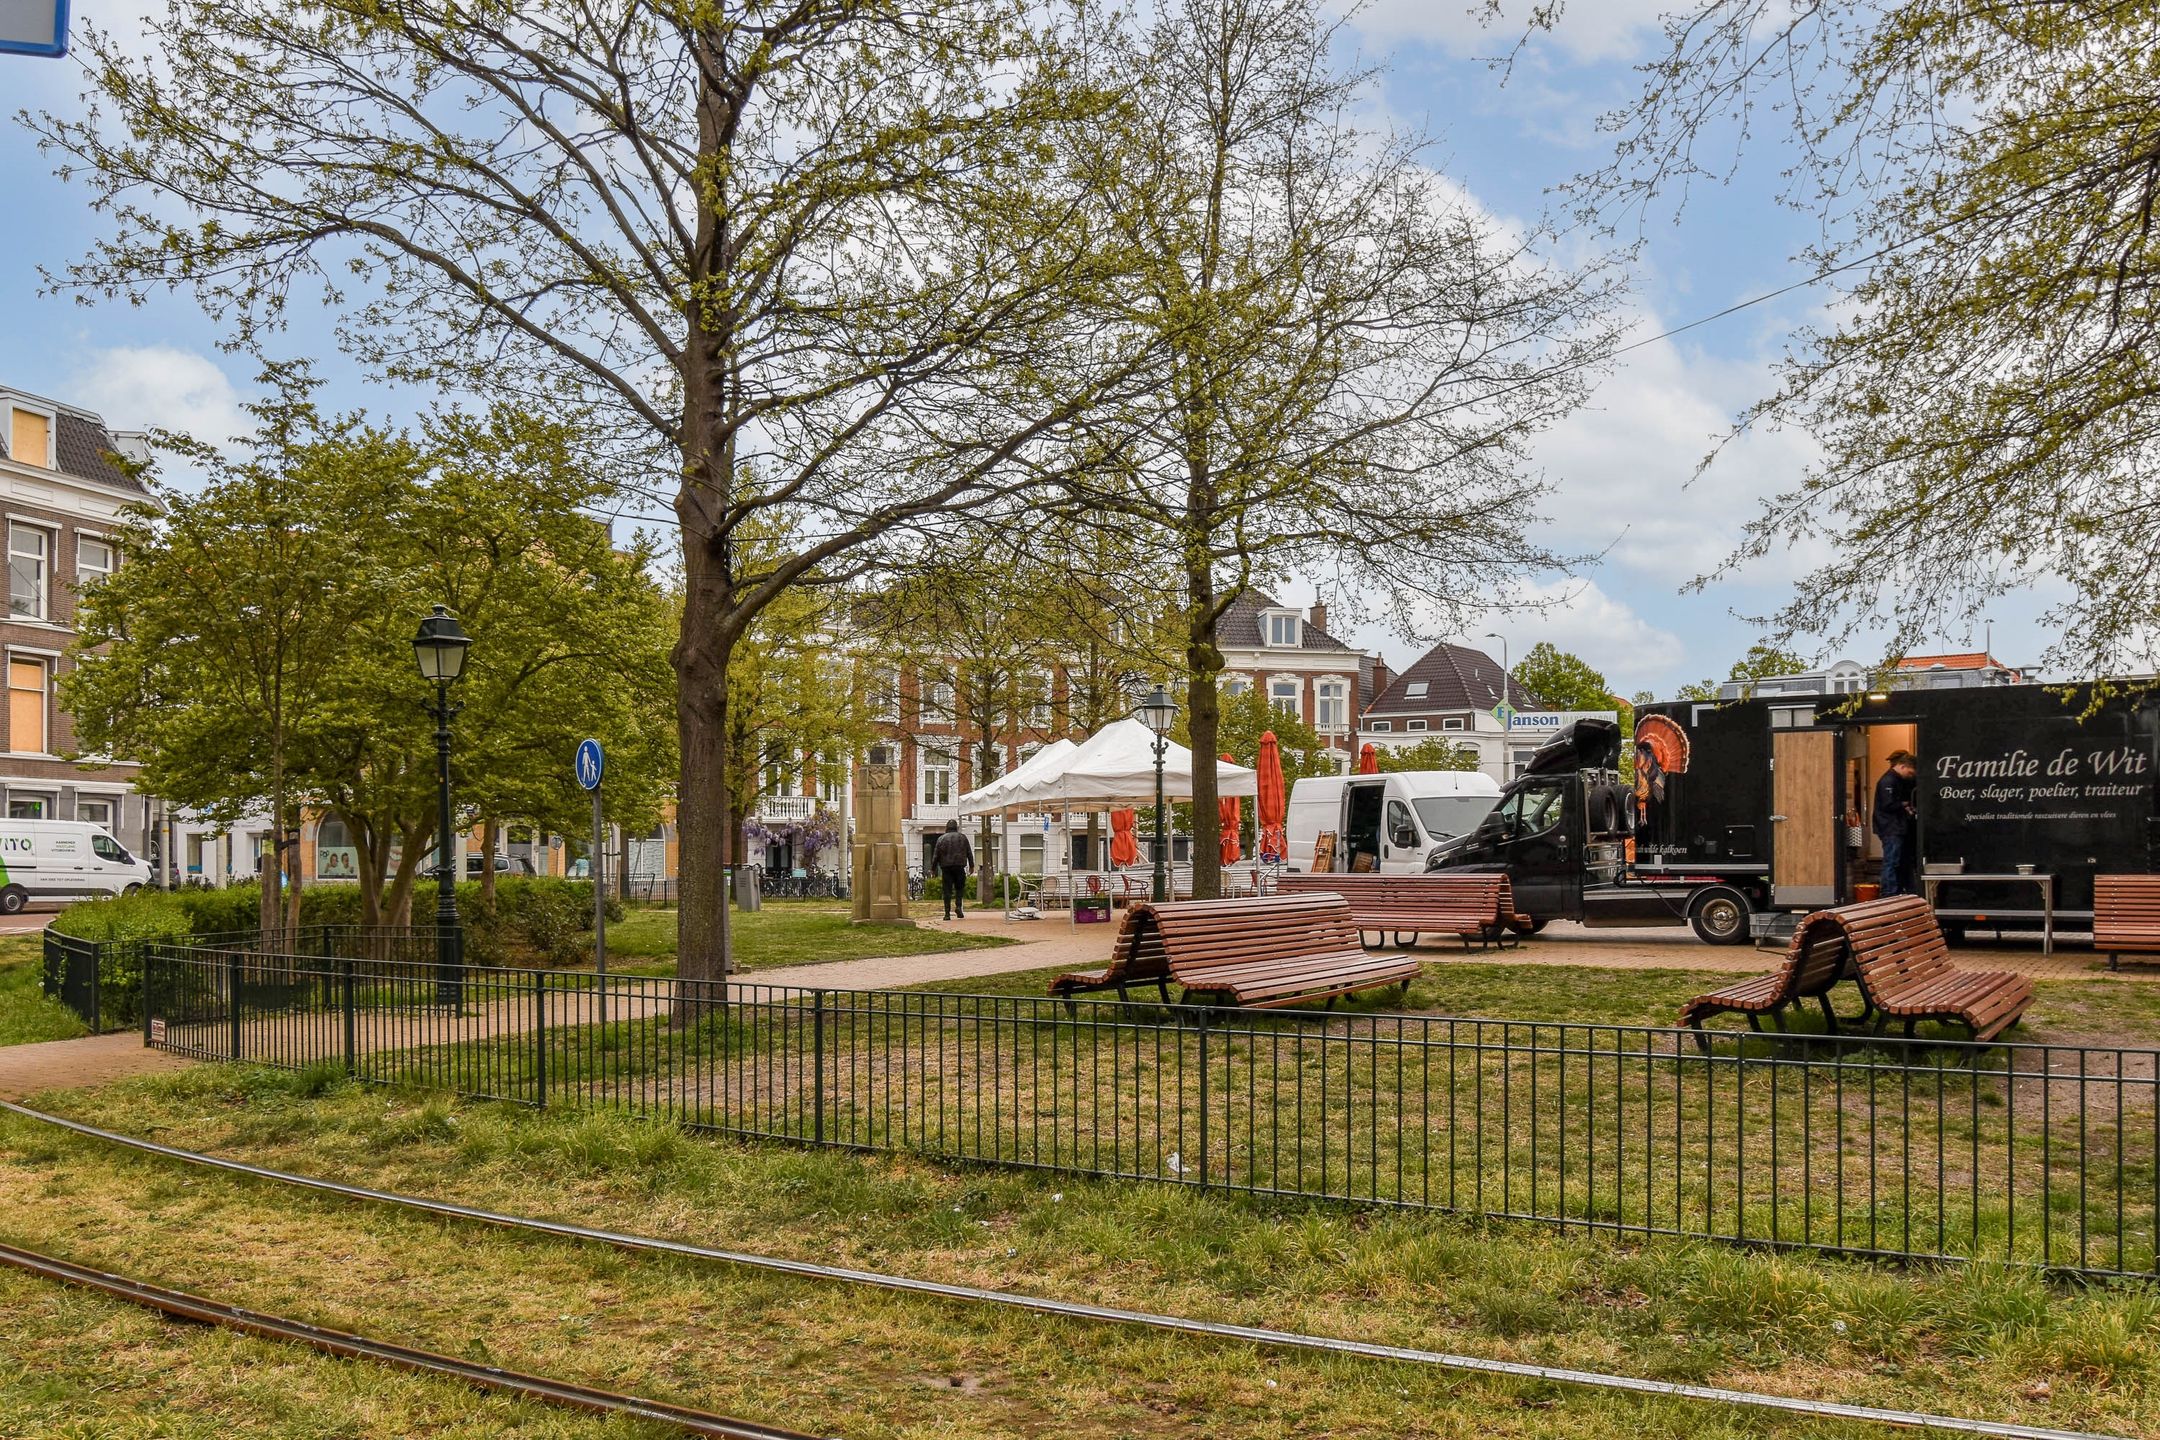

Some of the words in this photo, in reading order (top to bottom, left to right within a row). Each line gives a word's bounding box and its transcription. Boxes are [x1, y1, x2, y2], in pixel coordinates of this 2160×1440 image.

[1936, 749, 2040, 779] Familie
[2046, 748, 2079, 776] de
[2087, 746, 2148, 775] Wit
[1939, 786, 1976, 801] Boer,
[1979, 783, 2024, 803] slager,
[2026, 781, 2079, 802] poelier,
[2084, 782, 2144, 797] traiteur
[1964, 812, 1995, 822] Specialist
[0, 837, 33, 852] ITO
